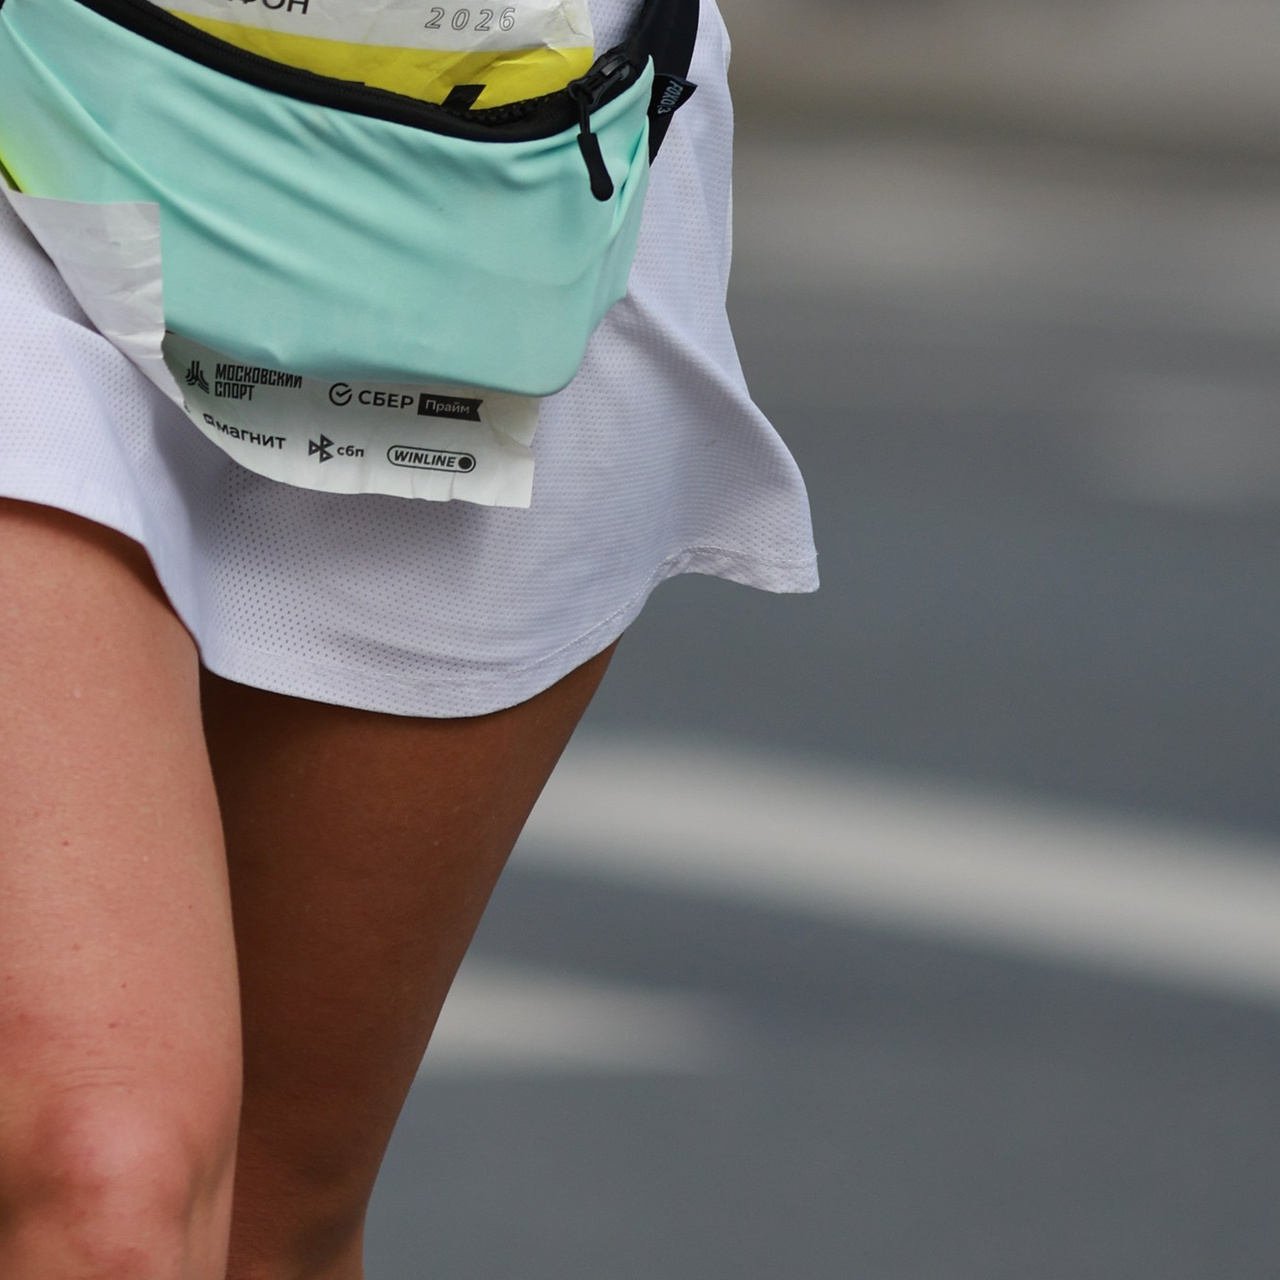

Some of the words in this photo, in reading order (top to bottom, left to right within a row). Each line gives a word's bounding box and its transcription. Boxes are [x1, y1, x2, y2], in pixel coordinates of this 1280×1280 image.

[424, 6, 516, 32] 2026
[214, 381, 255, 401] СПОРТ
[358, 390, 415, 409] СБЕР
[425, 399, 471, 414] Прайм
[336, 445, 365, 458] сбп
[394, 449, 457, 468] WINLINE
